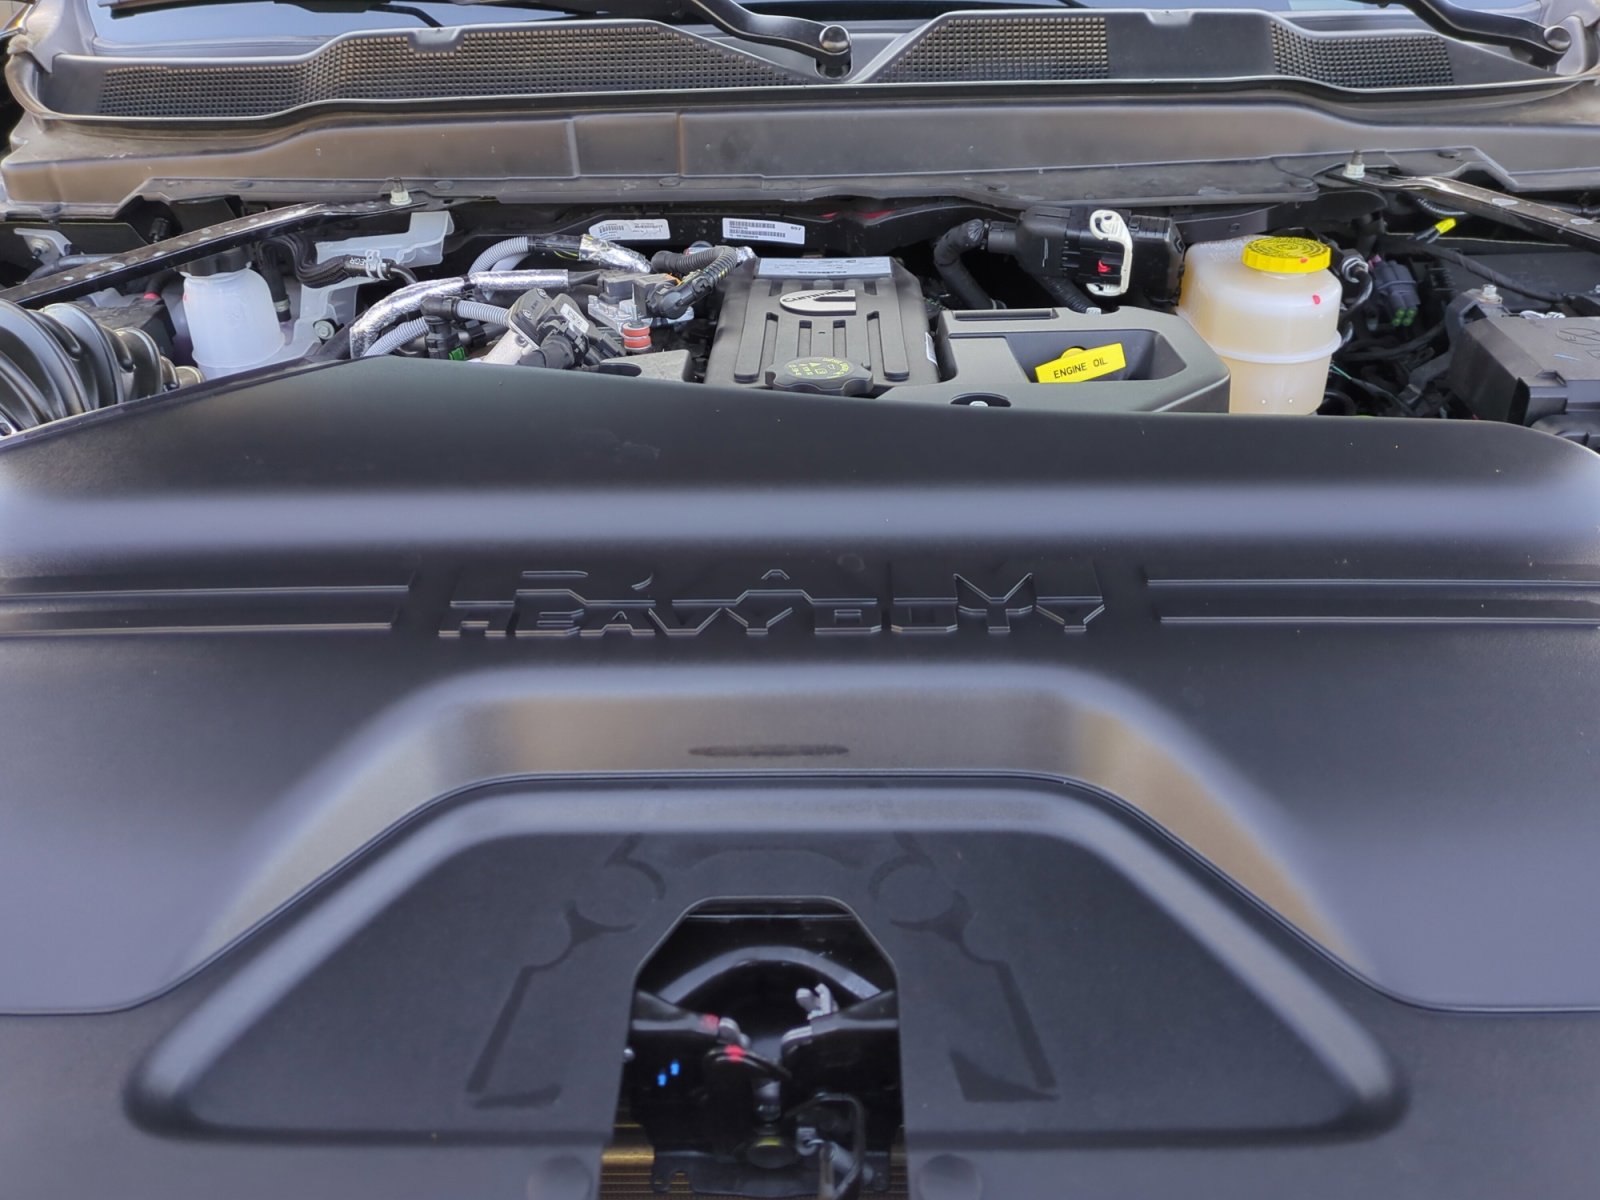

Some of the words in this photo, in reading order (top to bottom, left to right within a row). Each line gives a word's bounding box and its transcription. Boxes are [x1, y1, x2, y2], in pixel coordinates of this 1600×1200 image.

[1053, 362, 1087, 379] ENGINE
[1093, 357, 1108, 368] OIL
[437, 604, 793, 637] HEAVY
